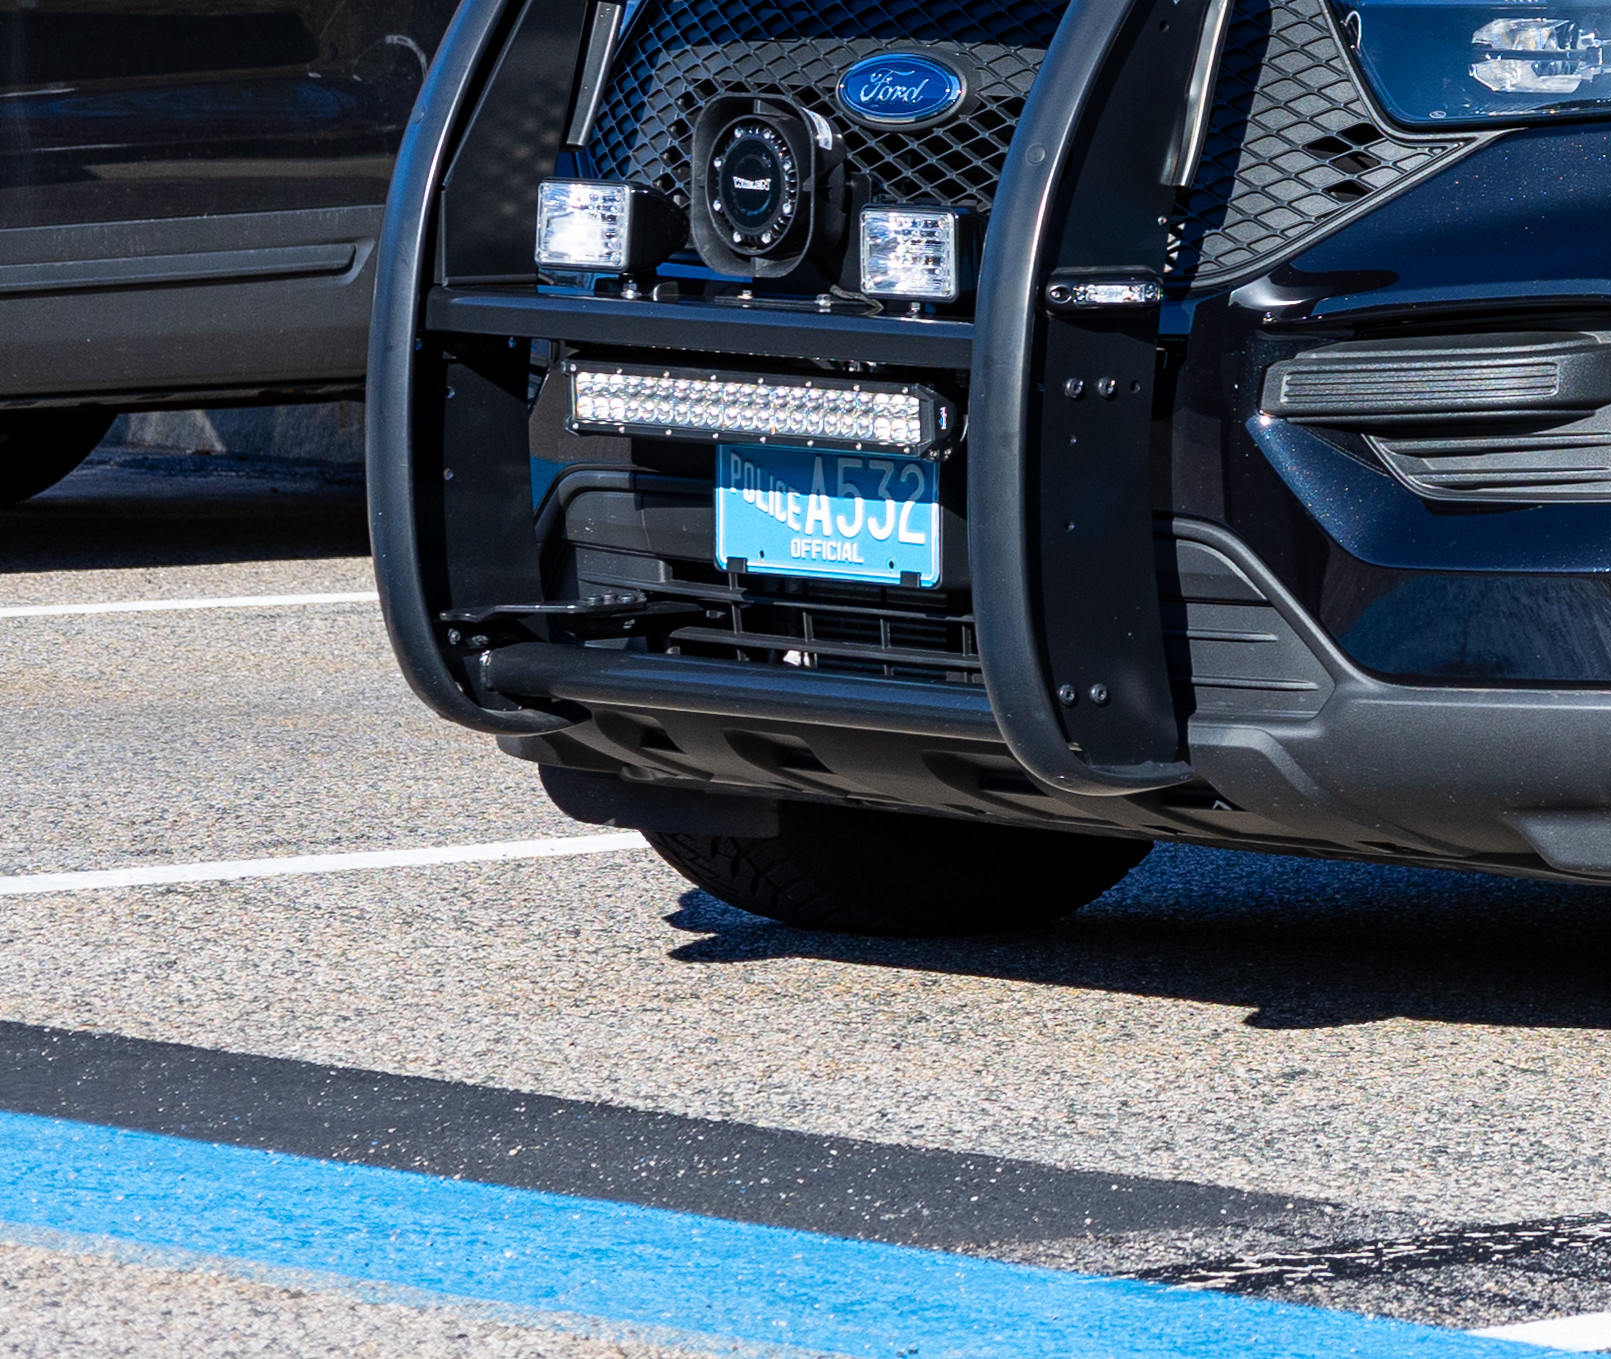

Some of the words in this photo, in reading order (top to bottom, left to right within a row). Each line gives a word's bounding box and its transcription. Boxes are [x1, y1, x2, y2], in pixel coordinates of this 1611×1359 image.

[860, 67, 930, 104] Ford
[730, 452, 801, 532] POLICE
[804, 456, 926, 544] A532
[790, 539, 864, 563] OFFICIAL
